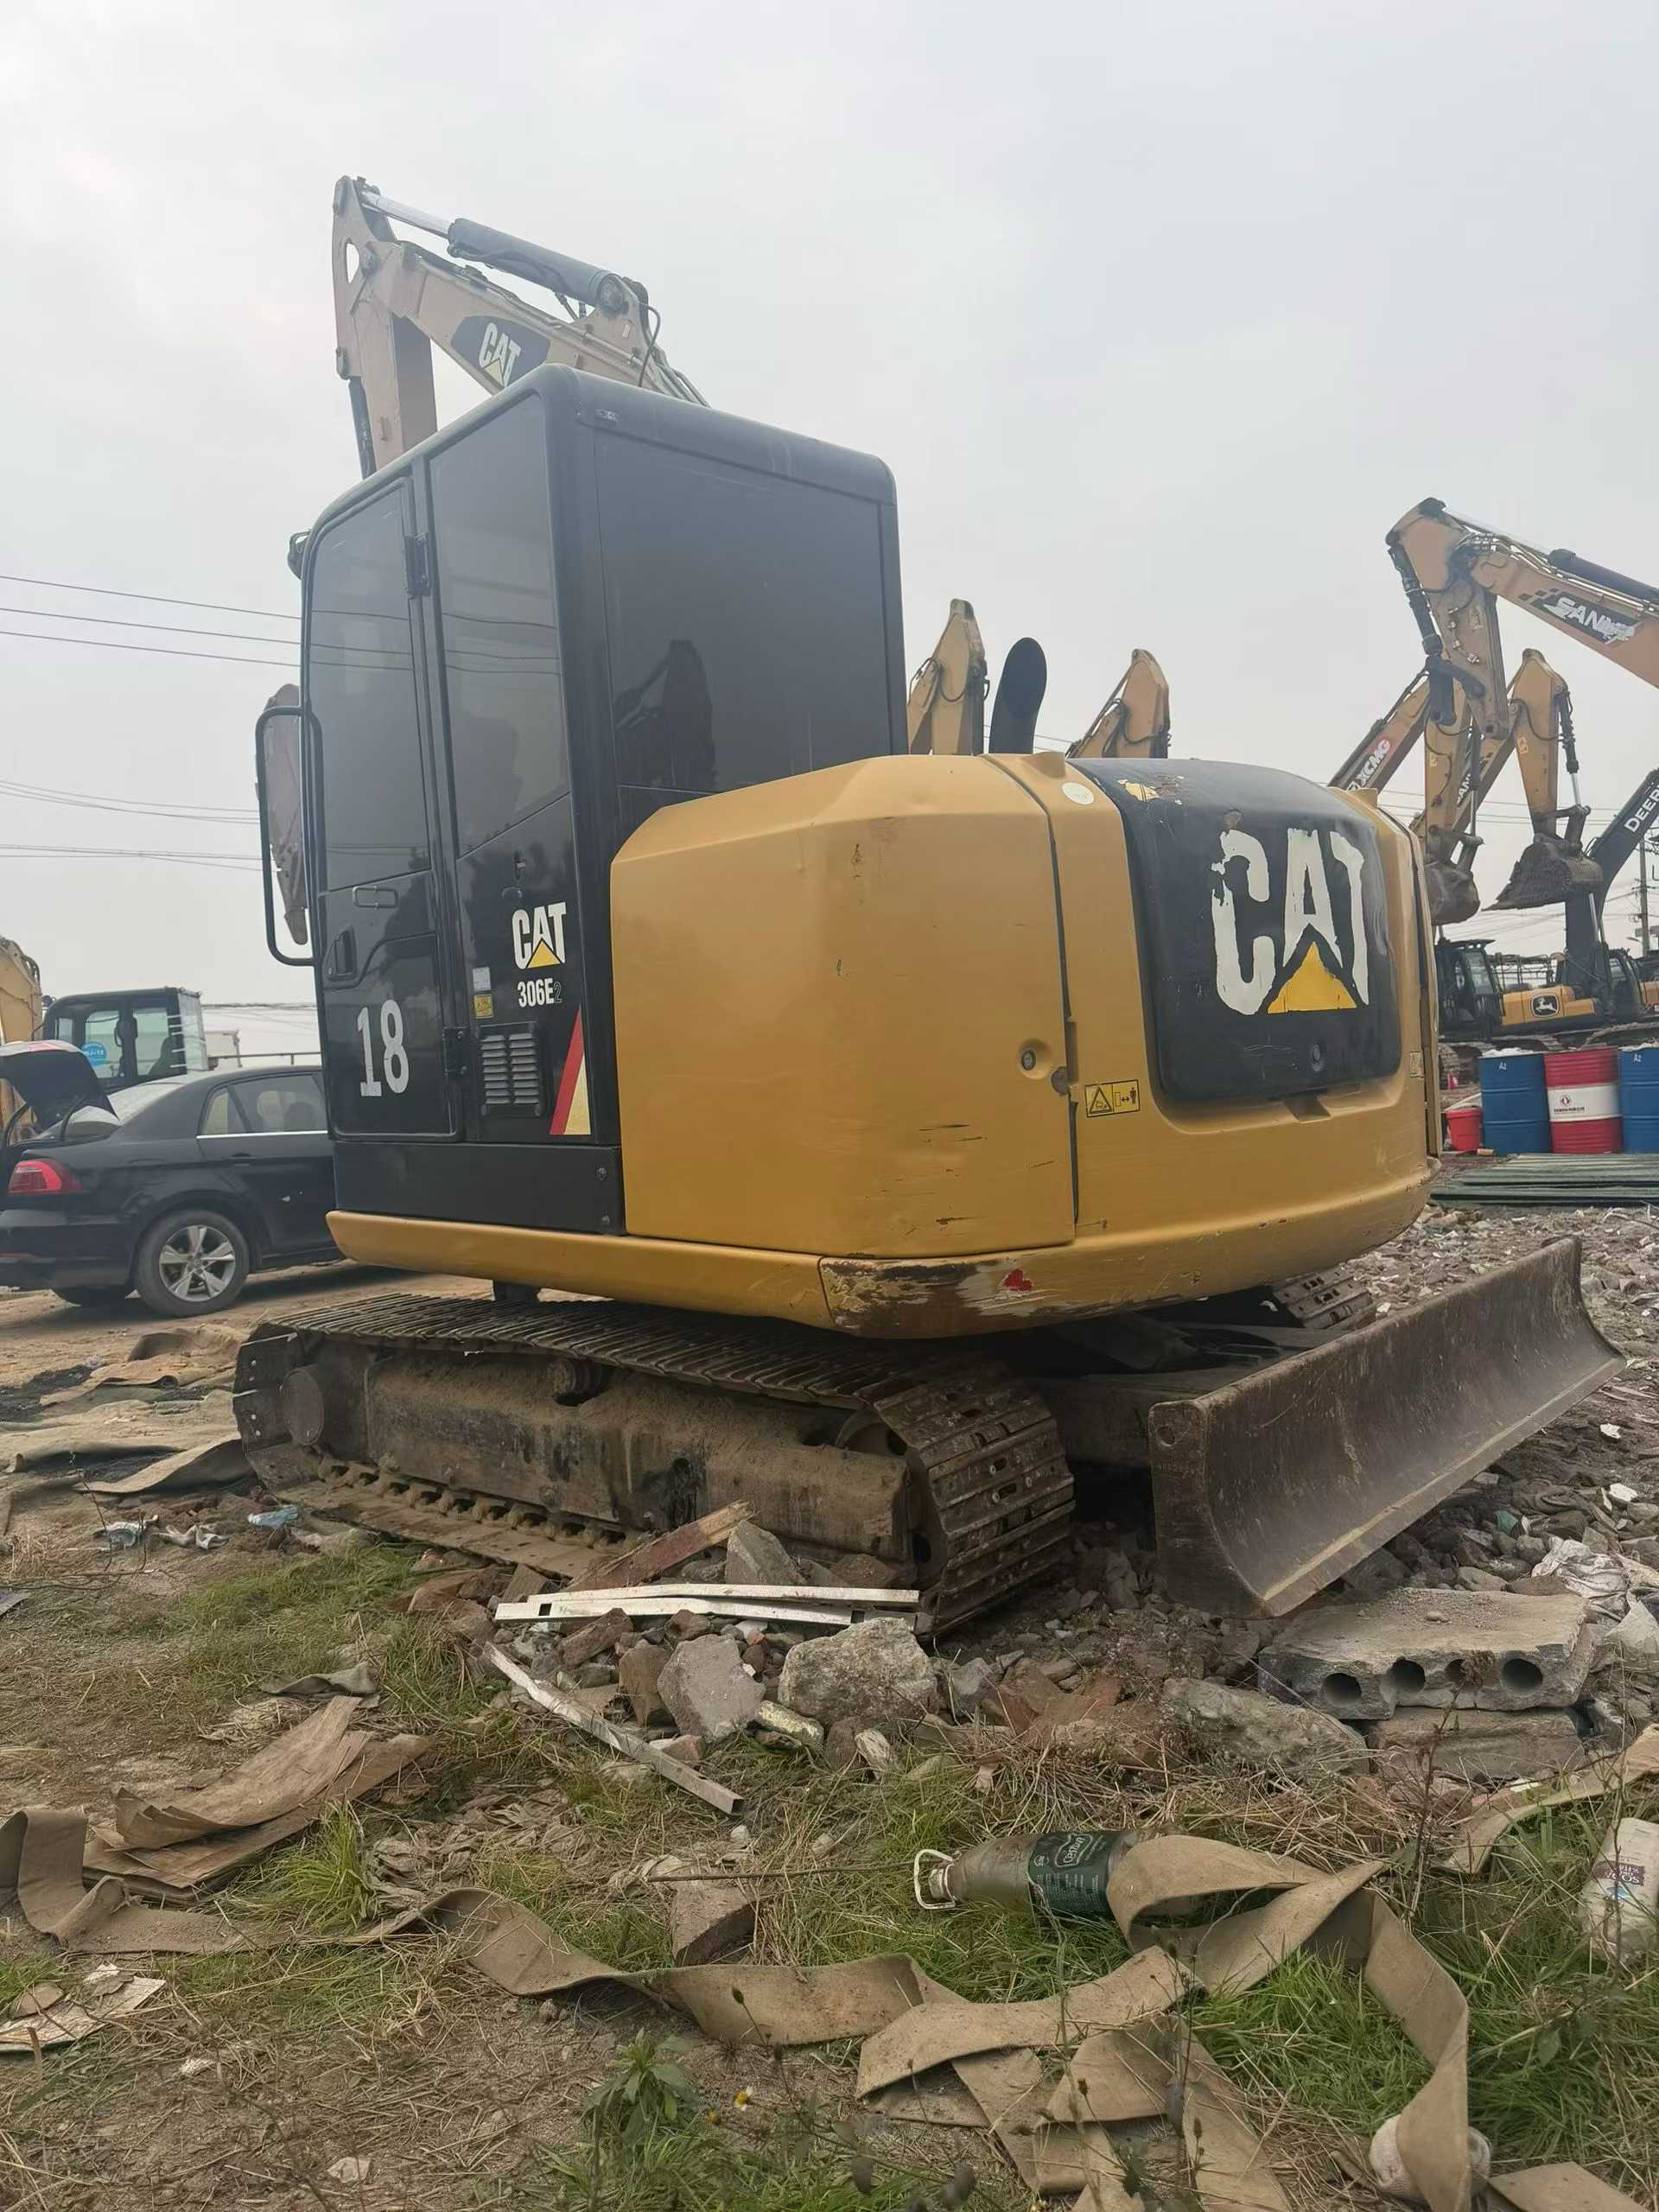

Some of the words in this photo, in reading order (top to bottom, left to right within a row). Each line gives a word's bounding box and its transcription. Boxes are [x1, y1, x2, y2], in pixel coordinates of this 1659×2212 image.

[479, 321, 522, 389] CAT
[1542, 596, 1635, 645] SAN
[1624, 784, 1659, 834] DEER
[512, 901, 566, 969] CAT
[1211, 827, 1370, 1016] CAT
[517, 977, 563, 1008] 306E2
[357, 1000, 410, 1097] 18
